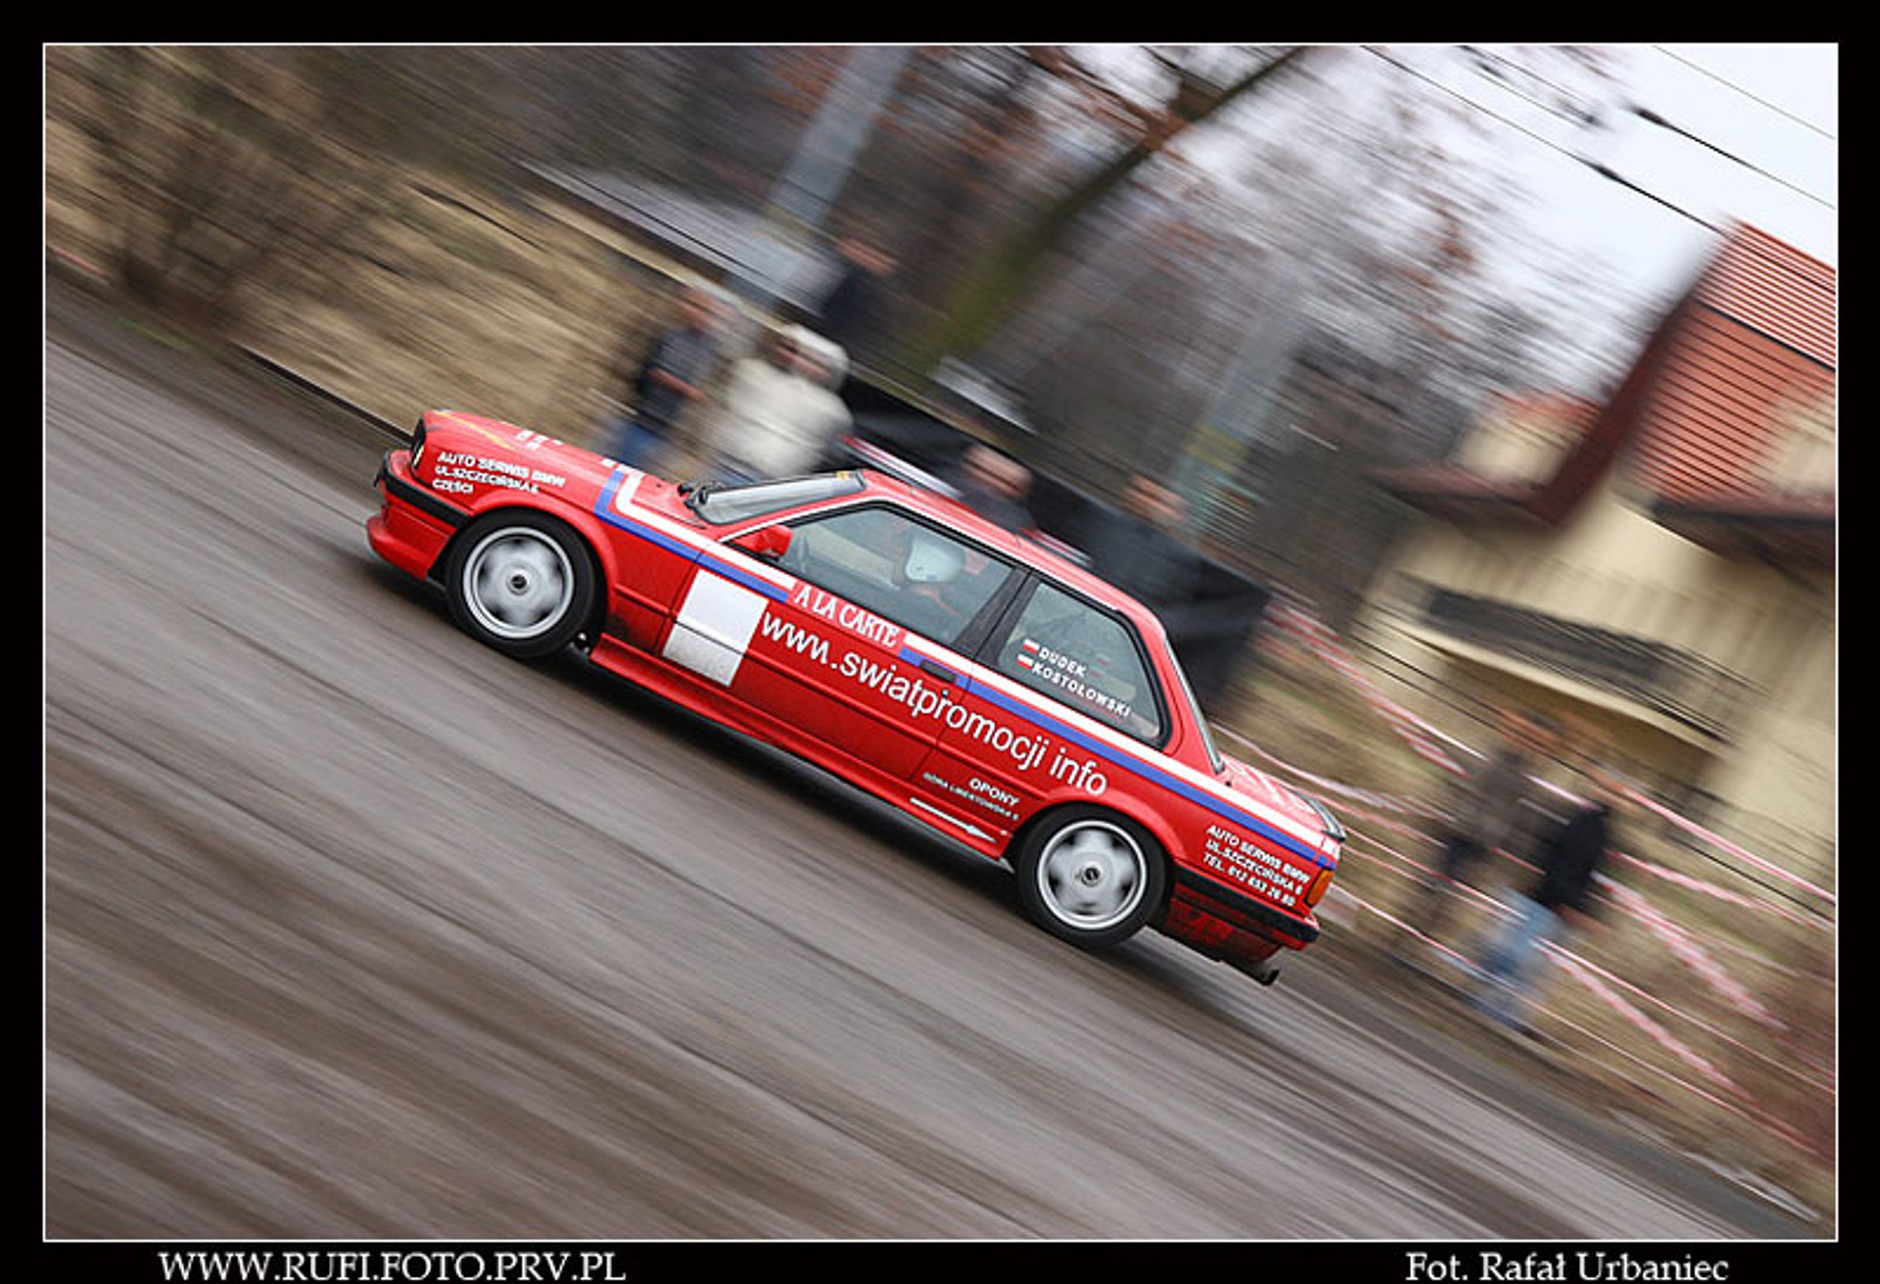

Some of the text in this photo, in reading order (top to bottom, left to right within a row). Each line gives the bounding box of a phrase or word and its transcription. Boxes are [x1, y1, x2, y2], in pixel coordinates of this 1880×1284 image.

[437, 452, 475, 467] AUTO
[795, 585, 900, 648] A LA CARTE
[1039, 647, 1087, 678] DUDEK
[1050, 747, 1107, 795] info
[969, 778, 1020, 807] OPONY
[1206, 825, 1239, 846] AUTO
